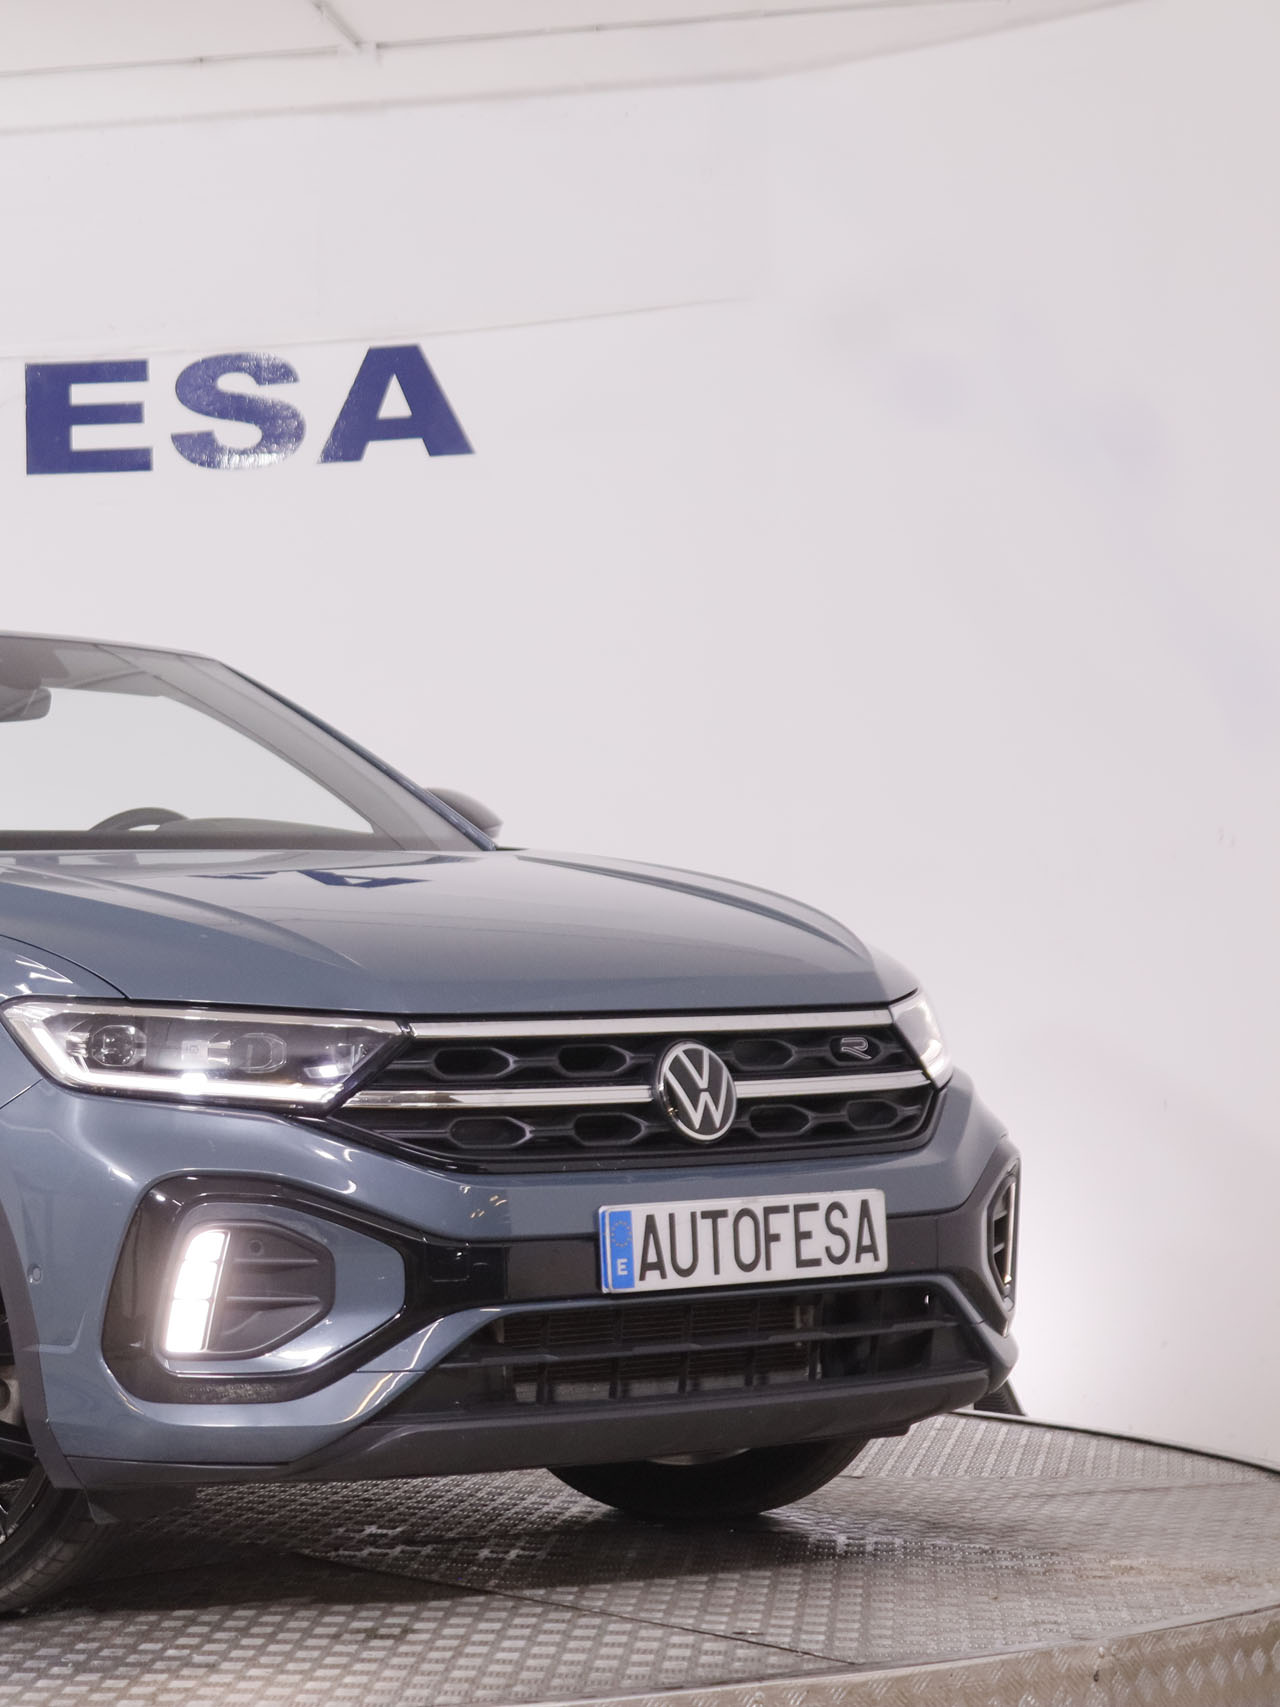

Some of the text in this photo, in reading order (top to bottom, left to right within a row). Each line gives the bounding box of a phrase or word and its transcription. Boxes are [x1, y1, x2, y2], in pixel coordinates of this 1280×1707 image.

[840, 1036, 872, 1060] R
[638, 1199, 880, 1281] AUTOFESA
[617, 1258, 629, 1276] E
